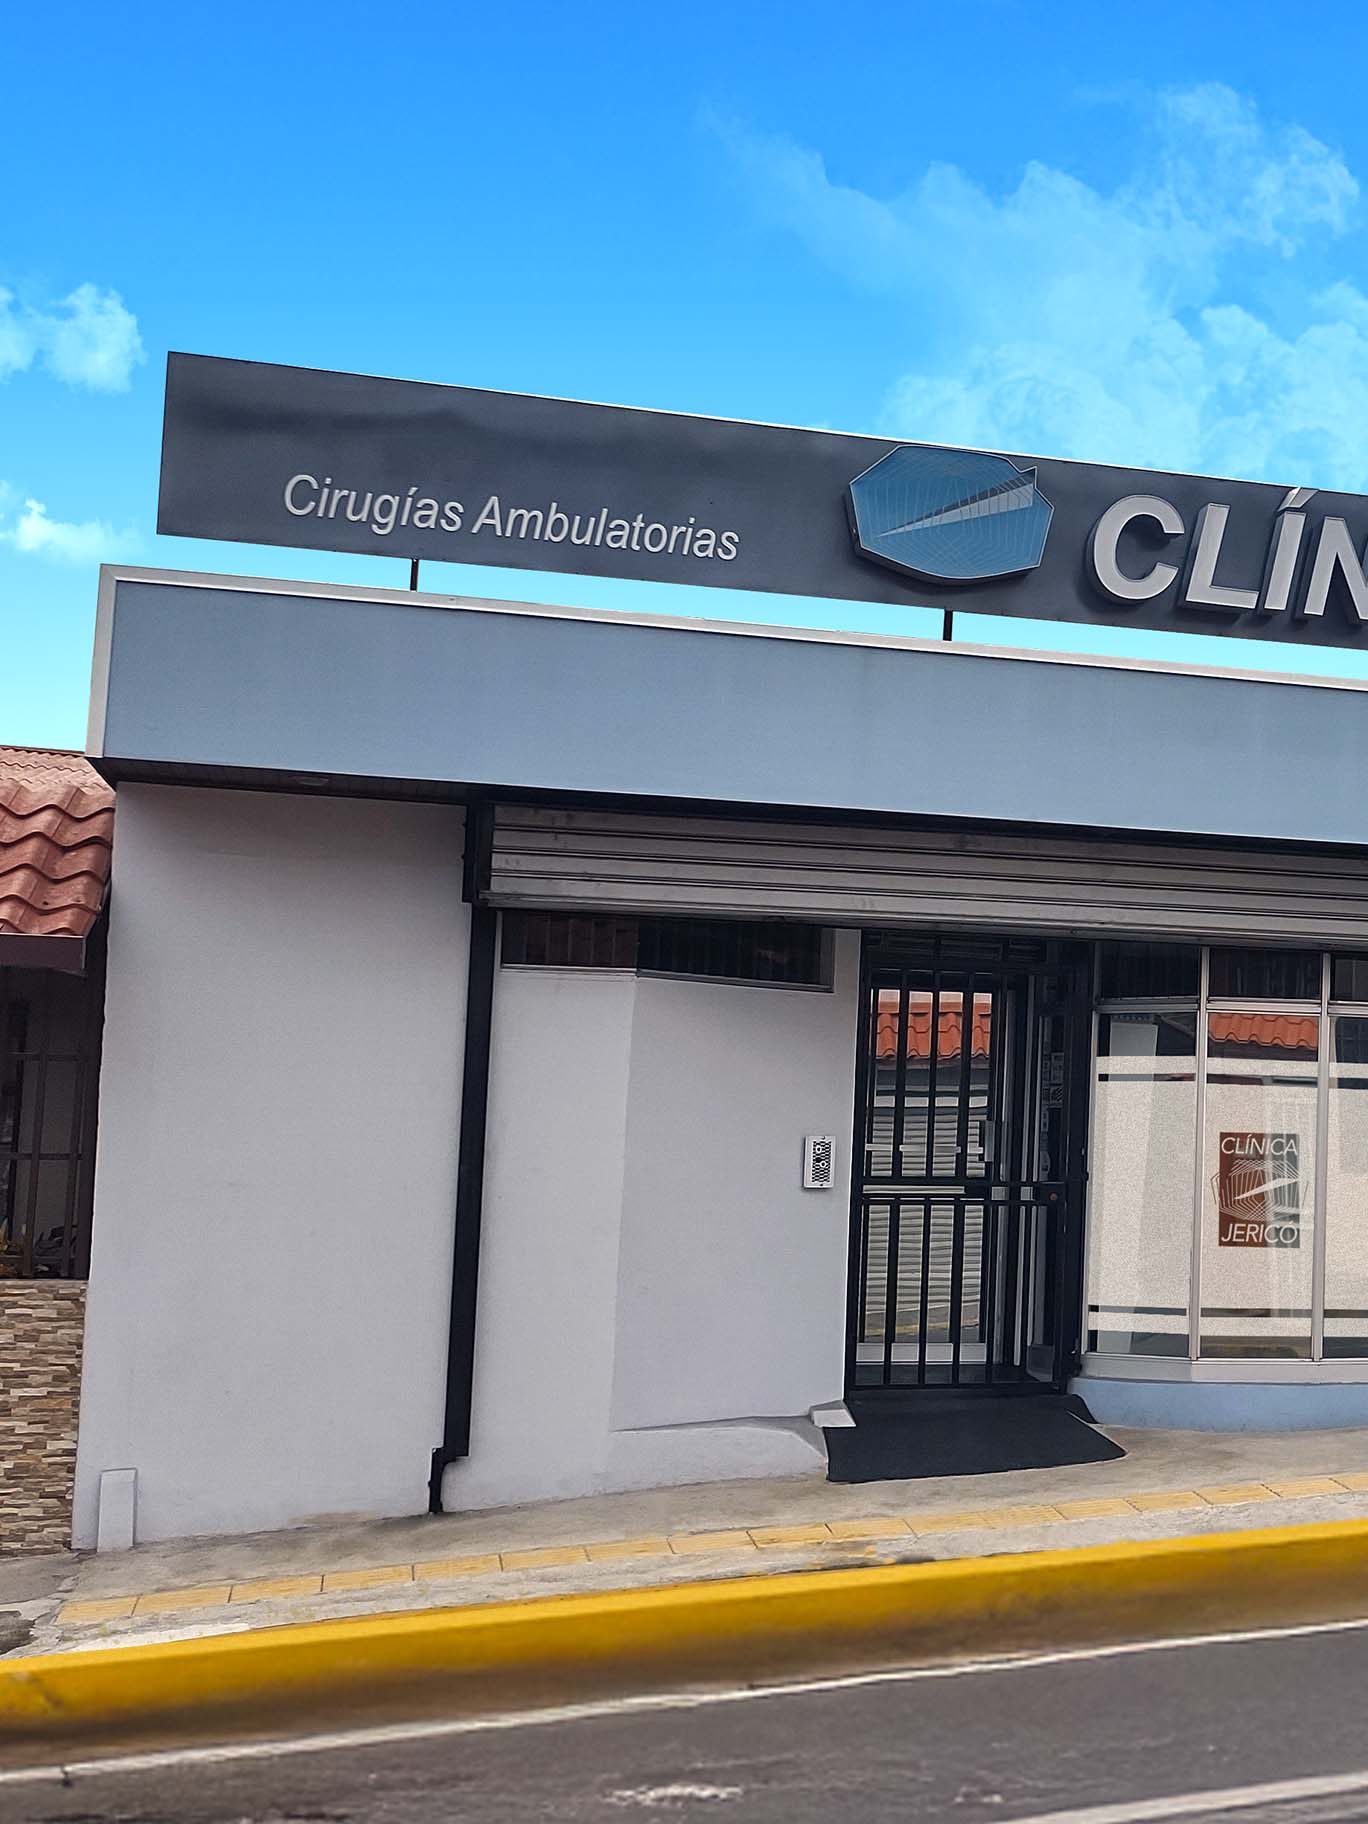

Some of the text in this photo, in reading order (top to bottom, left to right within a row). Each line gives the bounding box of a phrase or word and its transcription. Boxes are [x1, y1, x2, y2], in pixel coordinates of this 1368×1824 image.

[284, 474, 740, 561] Cirugías Ambulatorias
[1220, 1134, 1298, 1157] CLÍNICA
[1220, 1220, 1298, 1245] JERICÓ
